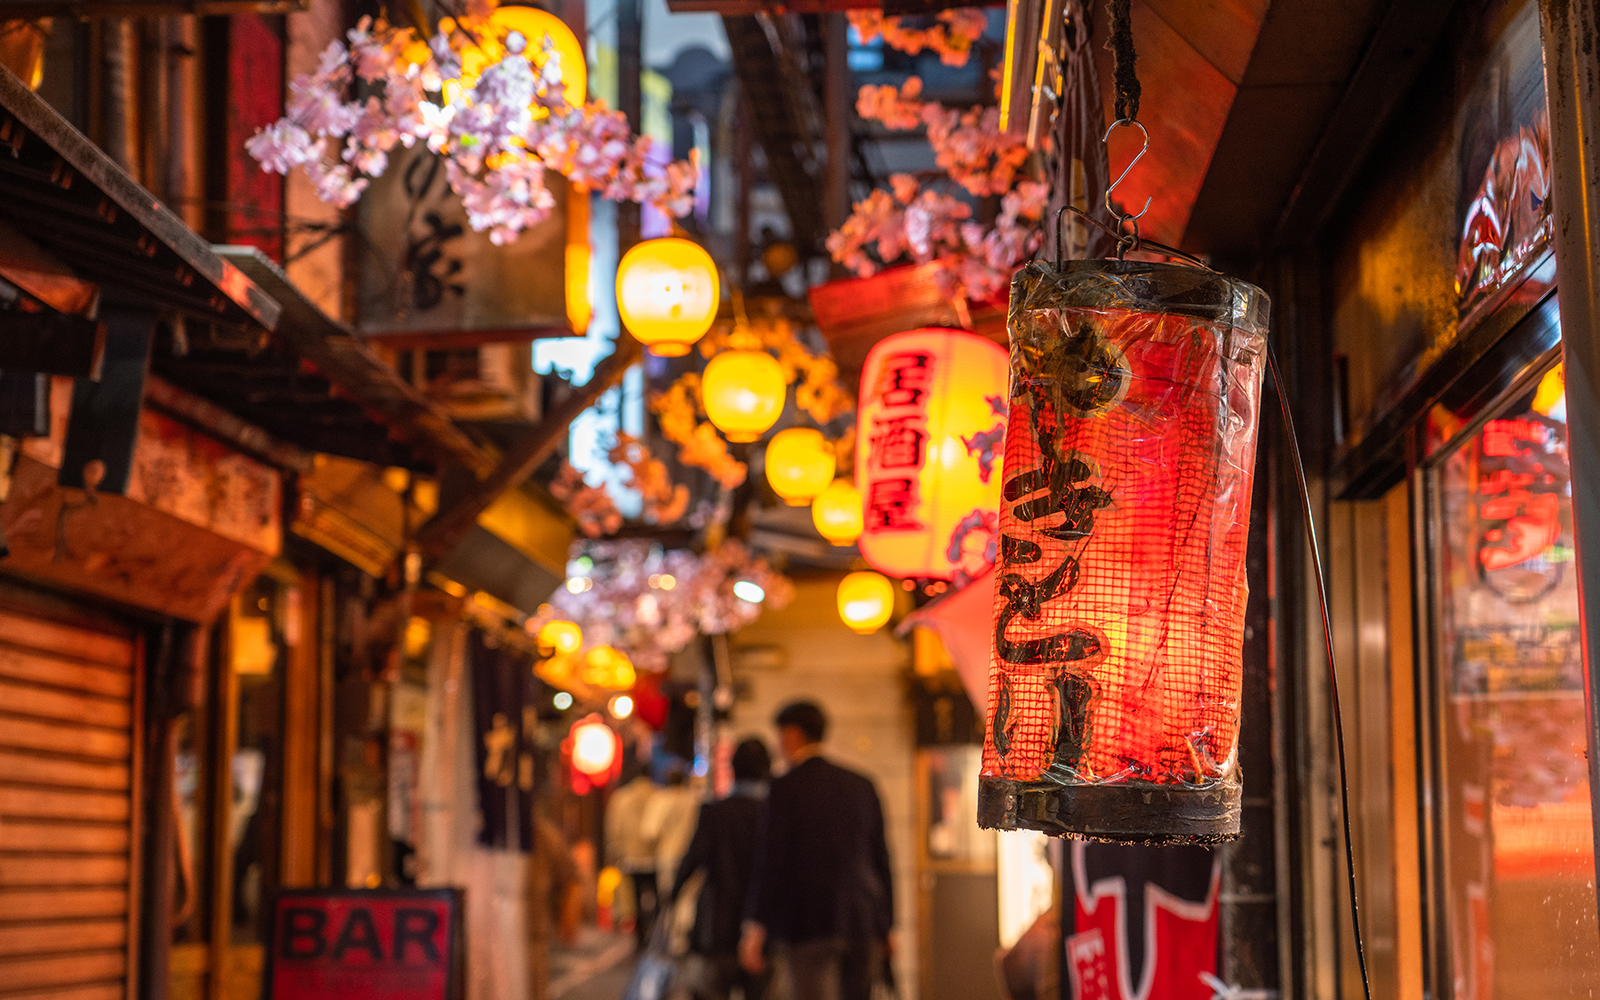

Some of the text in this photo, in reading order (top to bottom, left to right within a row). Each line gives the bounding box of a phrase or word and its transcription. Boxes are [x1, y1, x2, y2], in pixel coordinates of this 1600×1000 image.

[869, 352, 931, 533] 居酒屋
[283, 907, 439, 962] BAR
